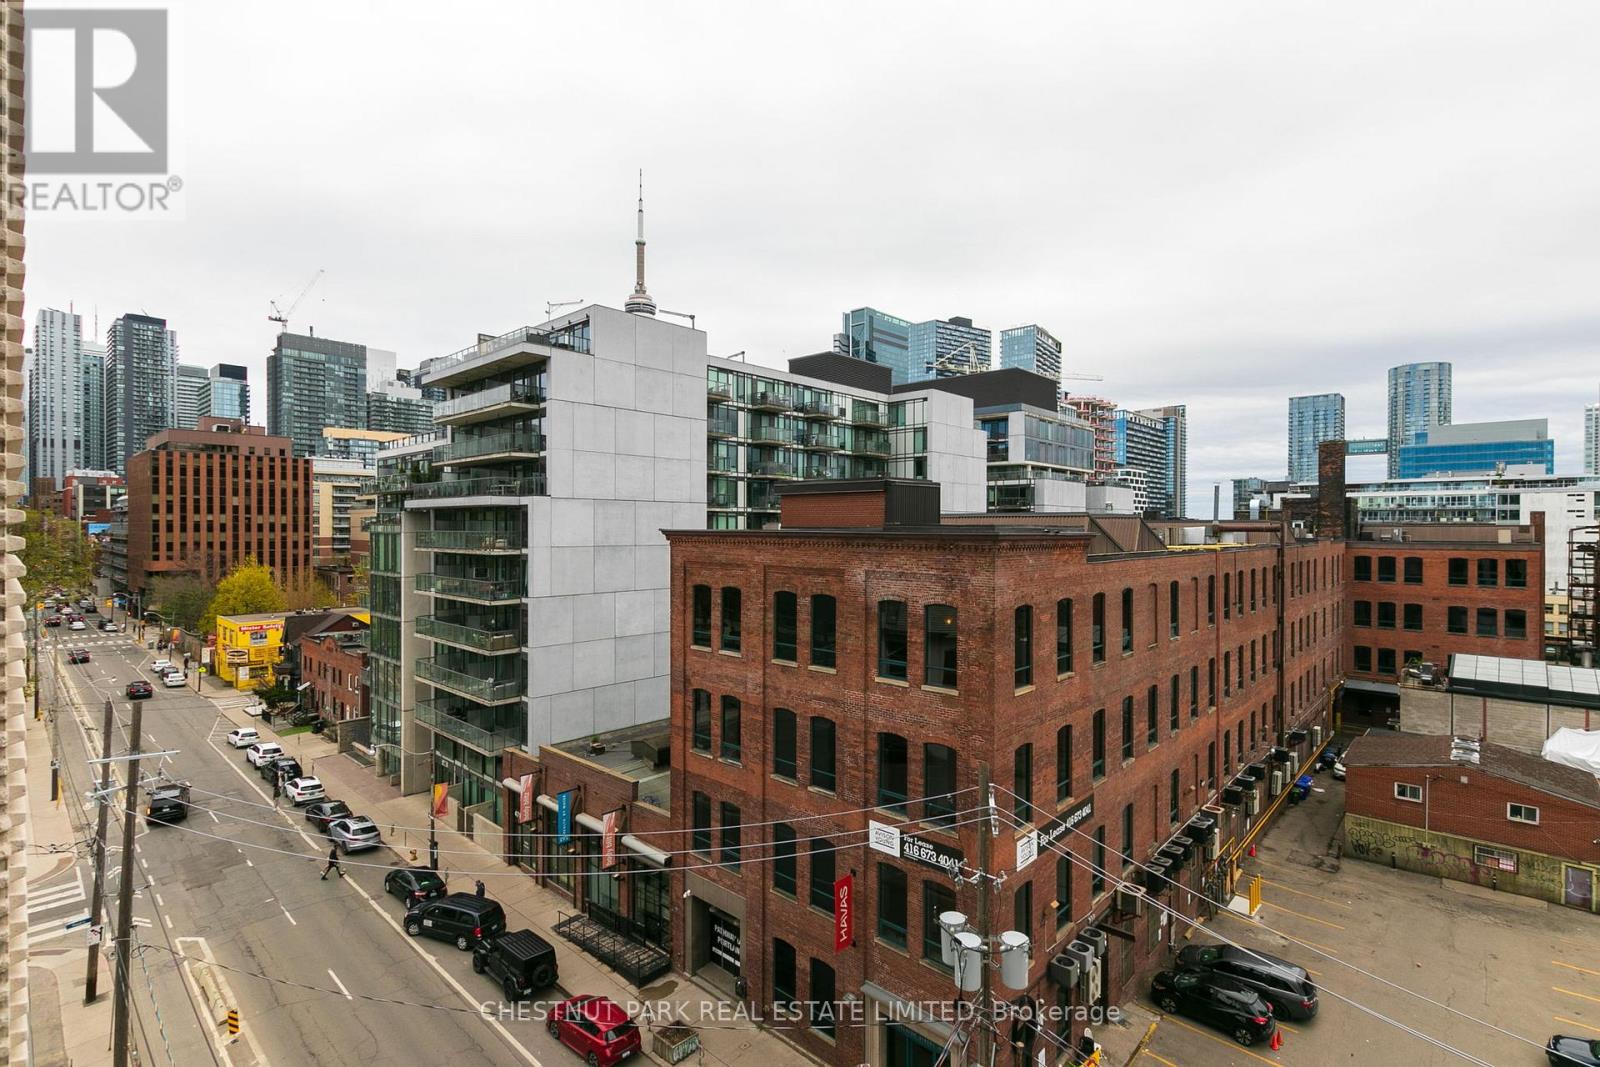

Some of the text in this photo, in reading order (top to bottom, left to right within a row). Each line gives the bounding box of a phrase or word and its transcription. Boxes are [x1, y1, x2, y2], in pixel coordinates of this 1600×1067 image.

[903, 843, 919, 856] 416
[920, 848, 936, 862] 673
[839, 886, 848, 943] HAVAS
